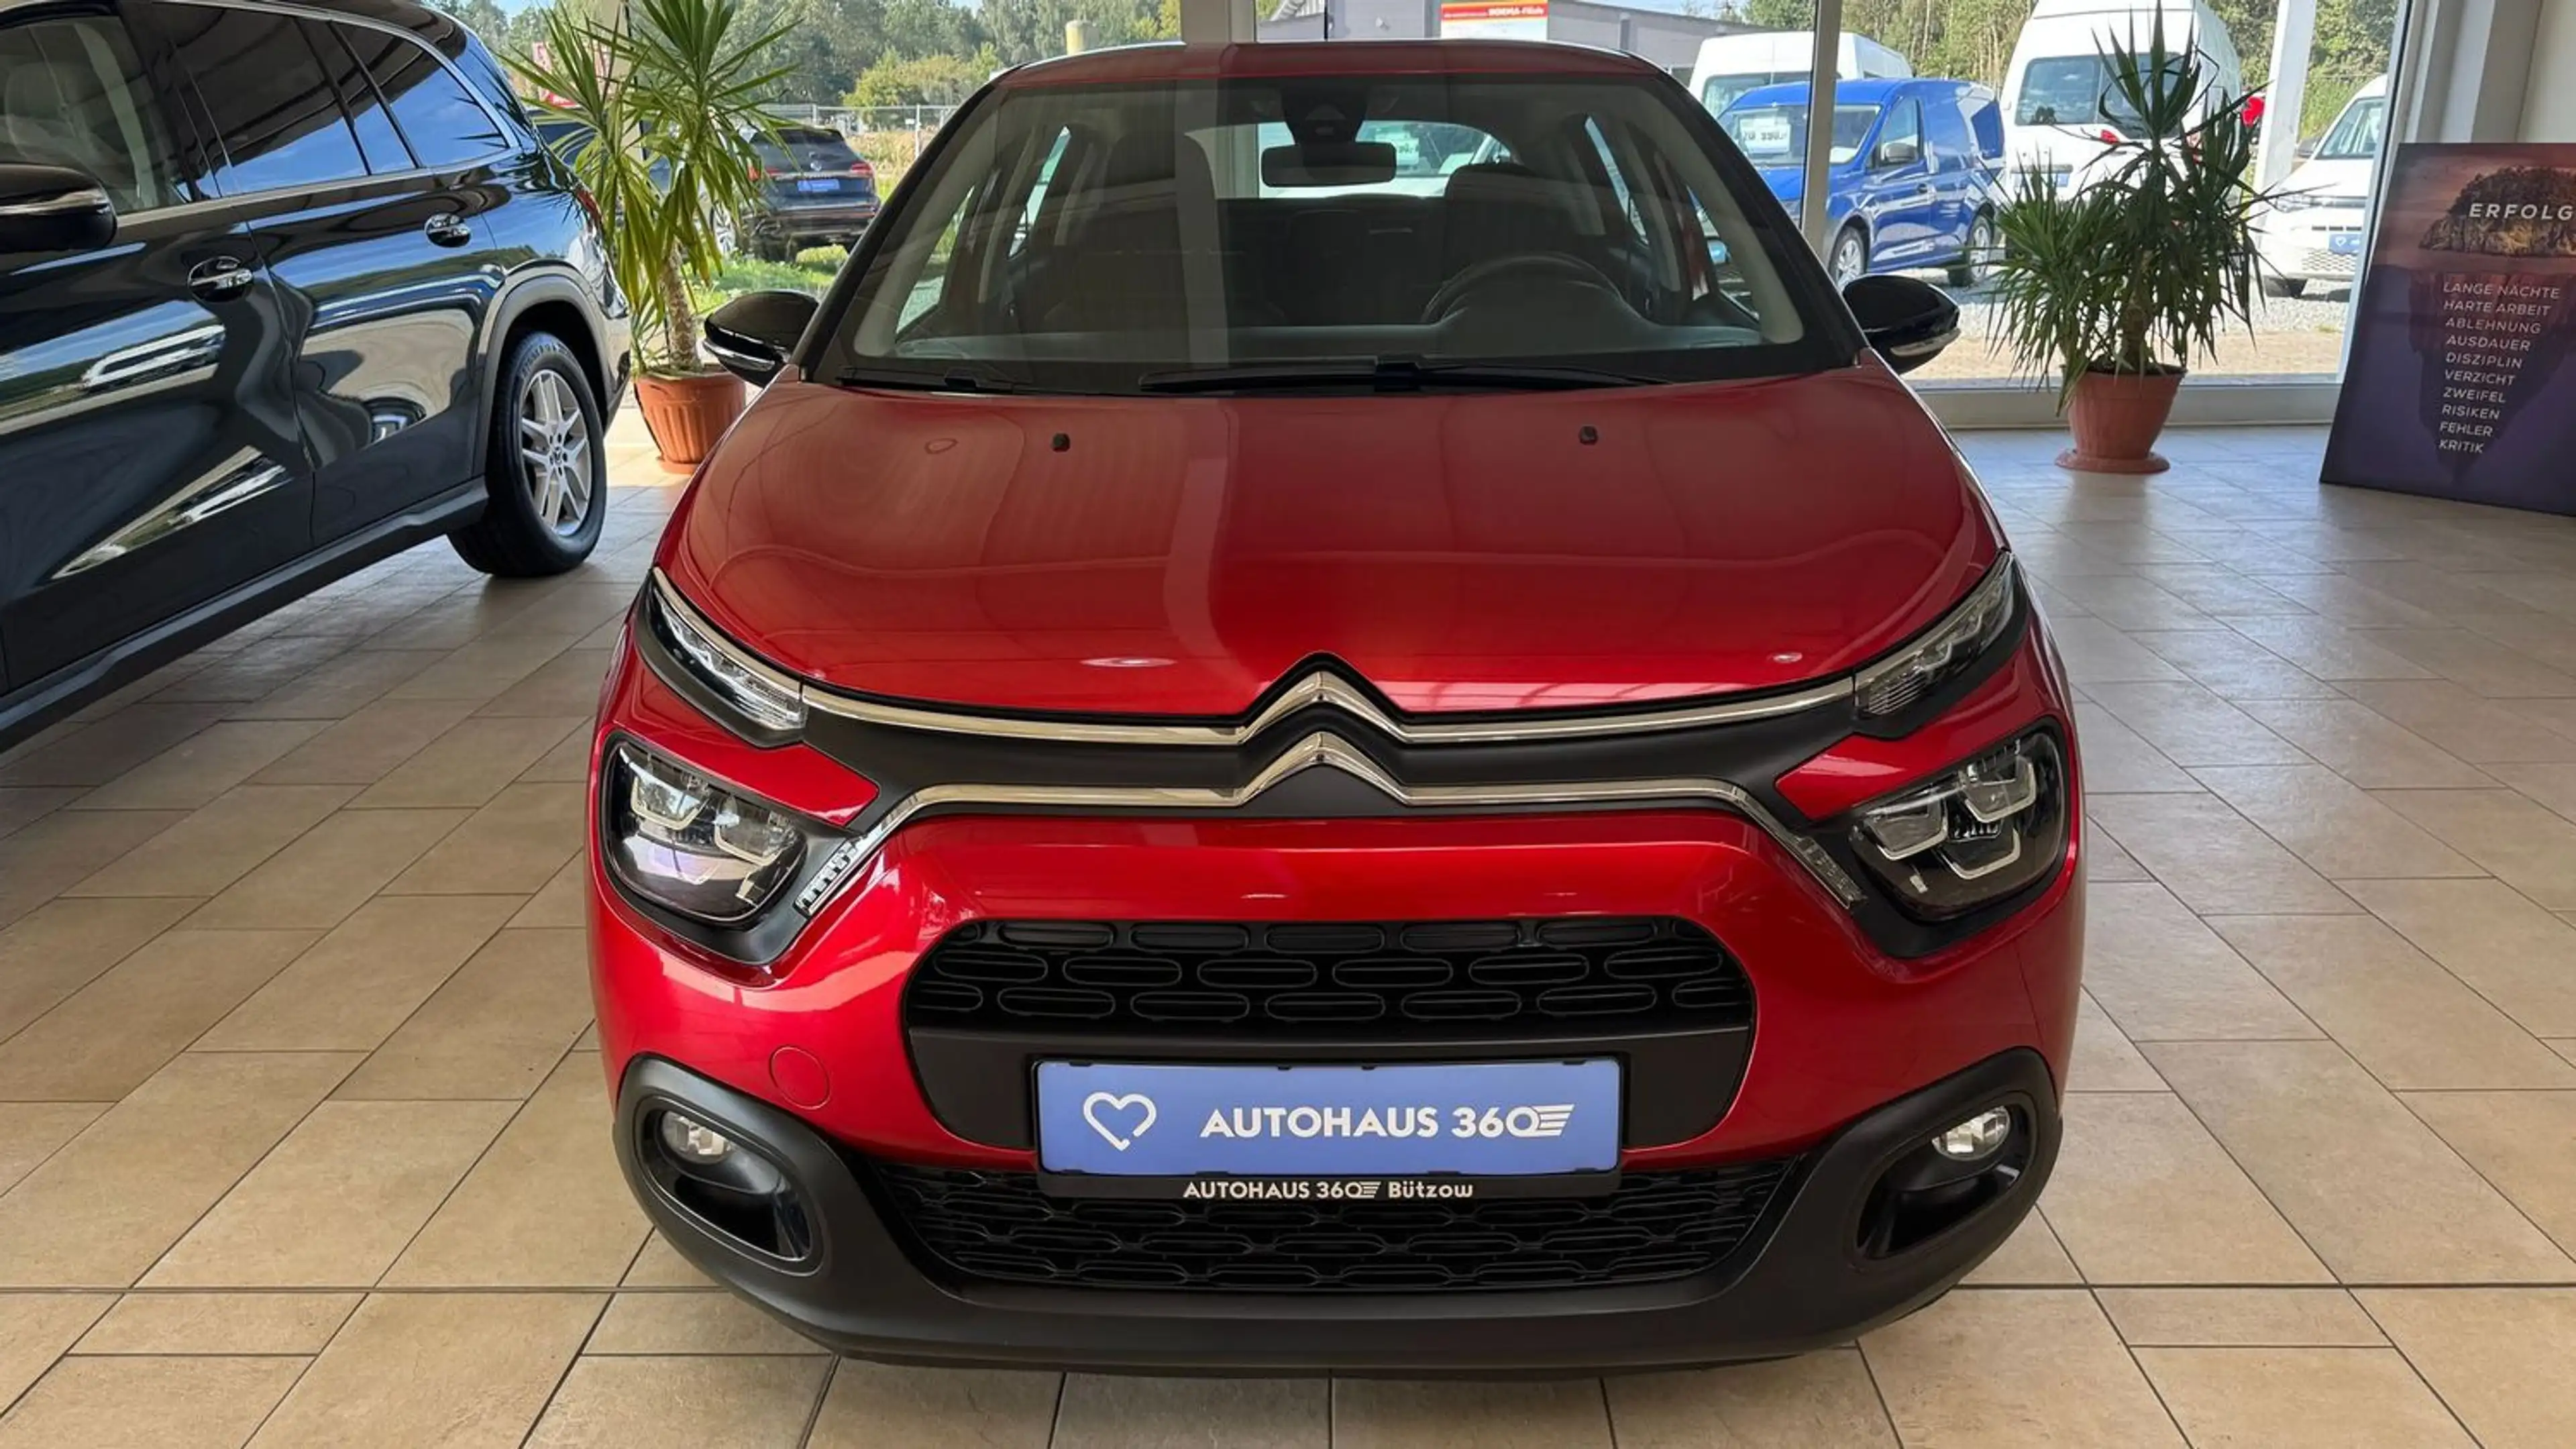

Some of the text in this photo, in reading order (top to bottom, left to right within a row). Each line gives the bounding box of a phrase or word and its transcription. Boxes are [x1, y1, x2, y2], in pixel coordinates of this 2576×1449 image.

[2469, 203, 2573, 221] ERFOLG
[2443, 282, 2493, 295] LANGE
[2443, 301, 2551, 316] HARTE ARBEIT
[2445, 317, 2542, 334] ABLEHNUNG
[2447, 335, 2530, 352] AUSDAUER
[2445, 352, 2523, 369] DISZIPLIN
[2445, 369, 2516, 386] VERZICHT
[2443, 386, 2506, 403] ZWEIFEL
[2442, 403, 2500, 420] RISIKEN
[2439, 421, 2493, 437] FEHLER
[2438, 439, 2485, 453] KRITIK
[1200, 1107, 1439, 1138] AUTOHAUS
[1183, 1181, 1311, 1200] AUTOHAUS
[1388, 1180, 1474, 1199] Bützow
